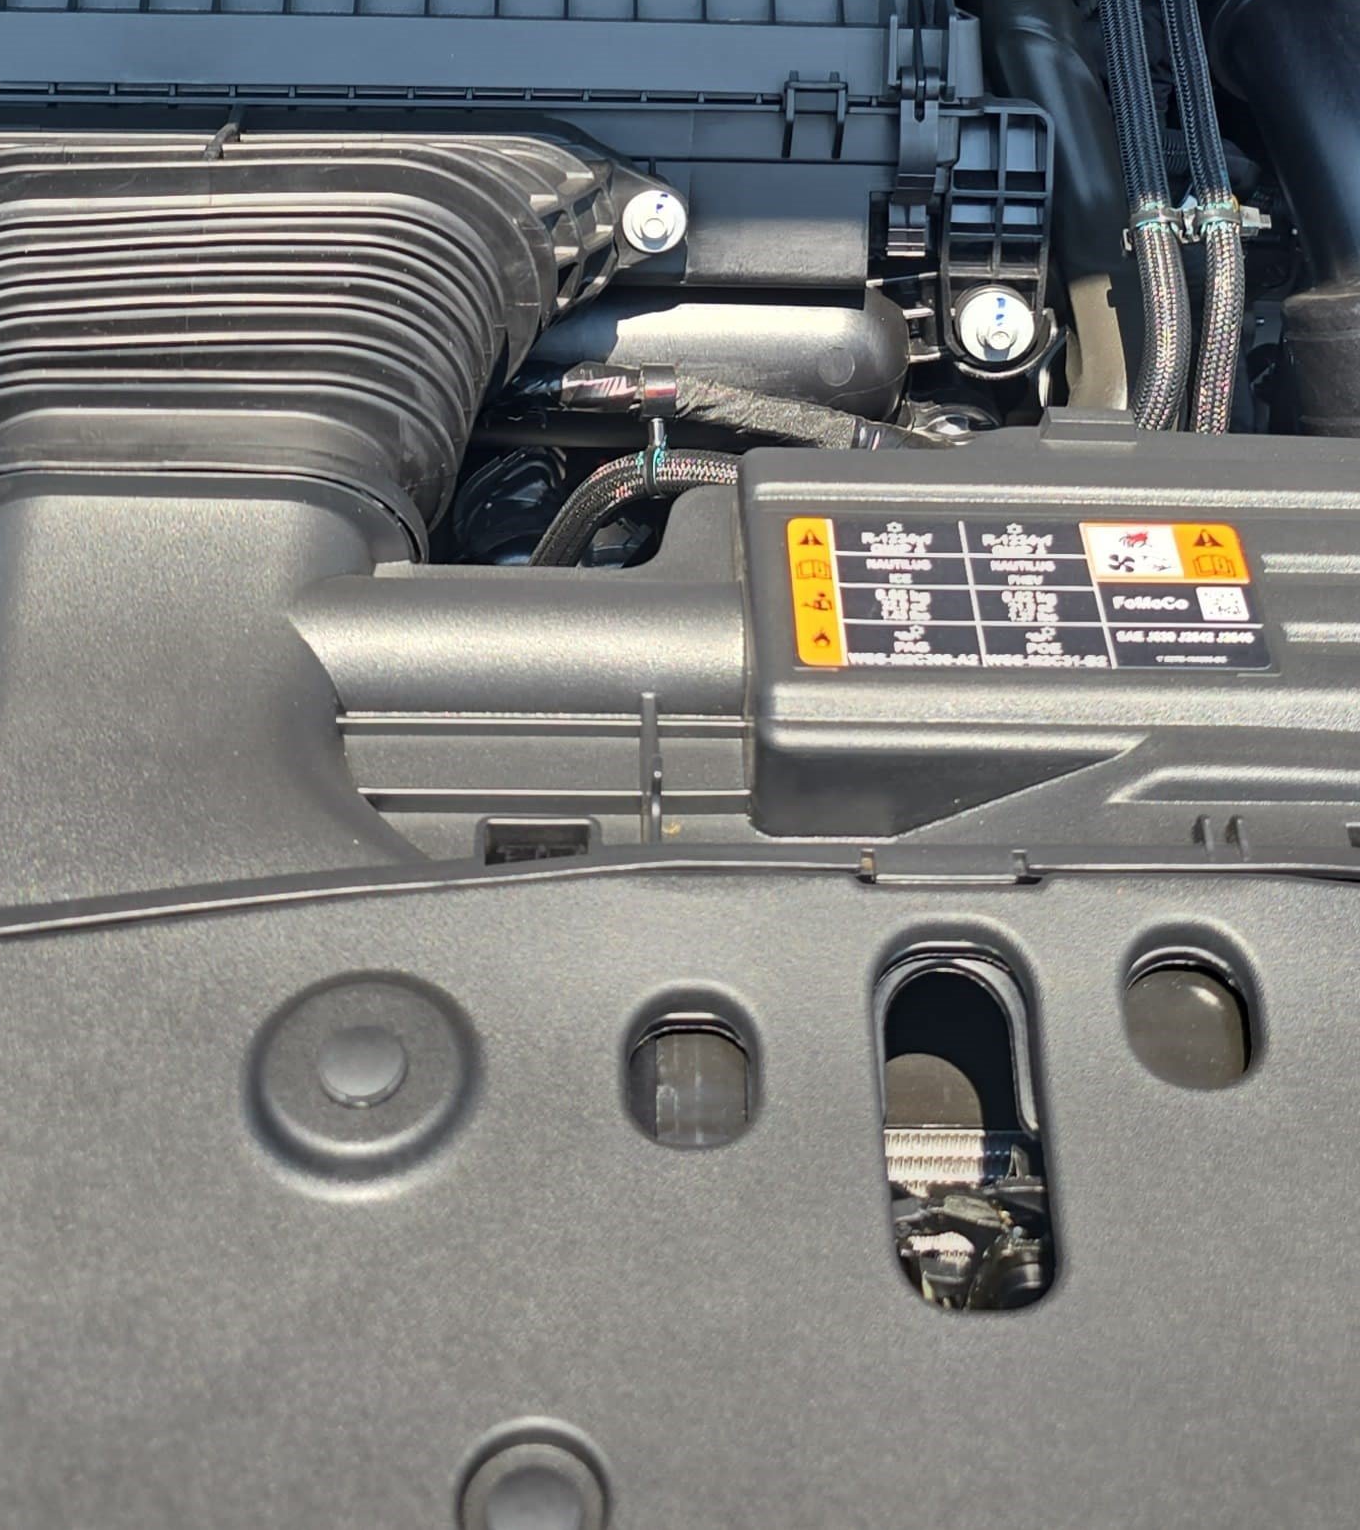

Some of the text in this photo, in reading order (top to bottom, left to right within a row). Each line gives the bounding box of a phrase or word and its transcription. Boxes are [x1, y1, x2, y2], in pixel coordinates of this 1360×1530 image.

[866, 559, 933, 572] NAUTILUS
[990, 560, 1057, 572] NAUTILUS
[1007, 574, 1044, 586] PHEV
[1112, 595, 1190, 611] FoMoCo
[1115, 630, 1145, 643] SAE
[893, 641, 931, 654] PAG
[1025, 641, 1064, 655] POE
